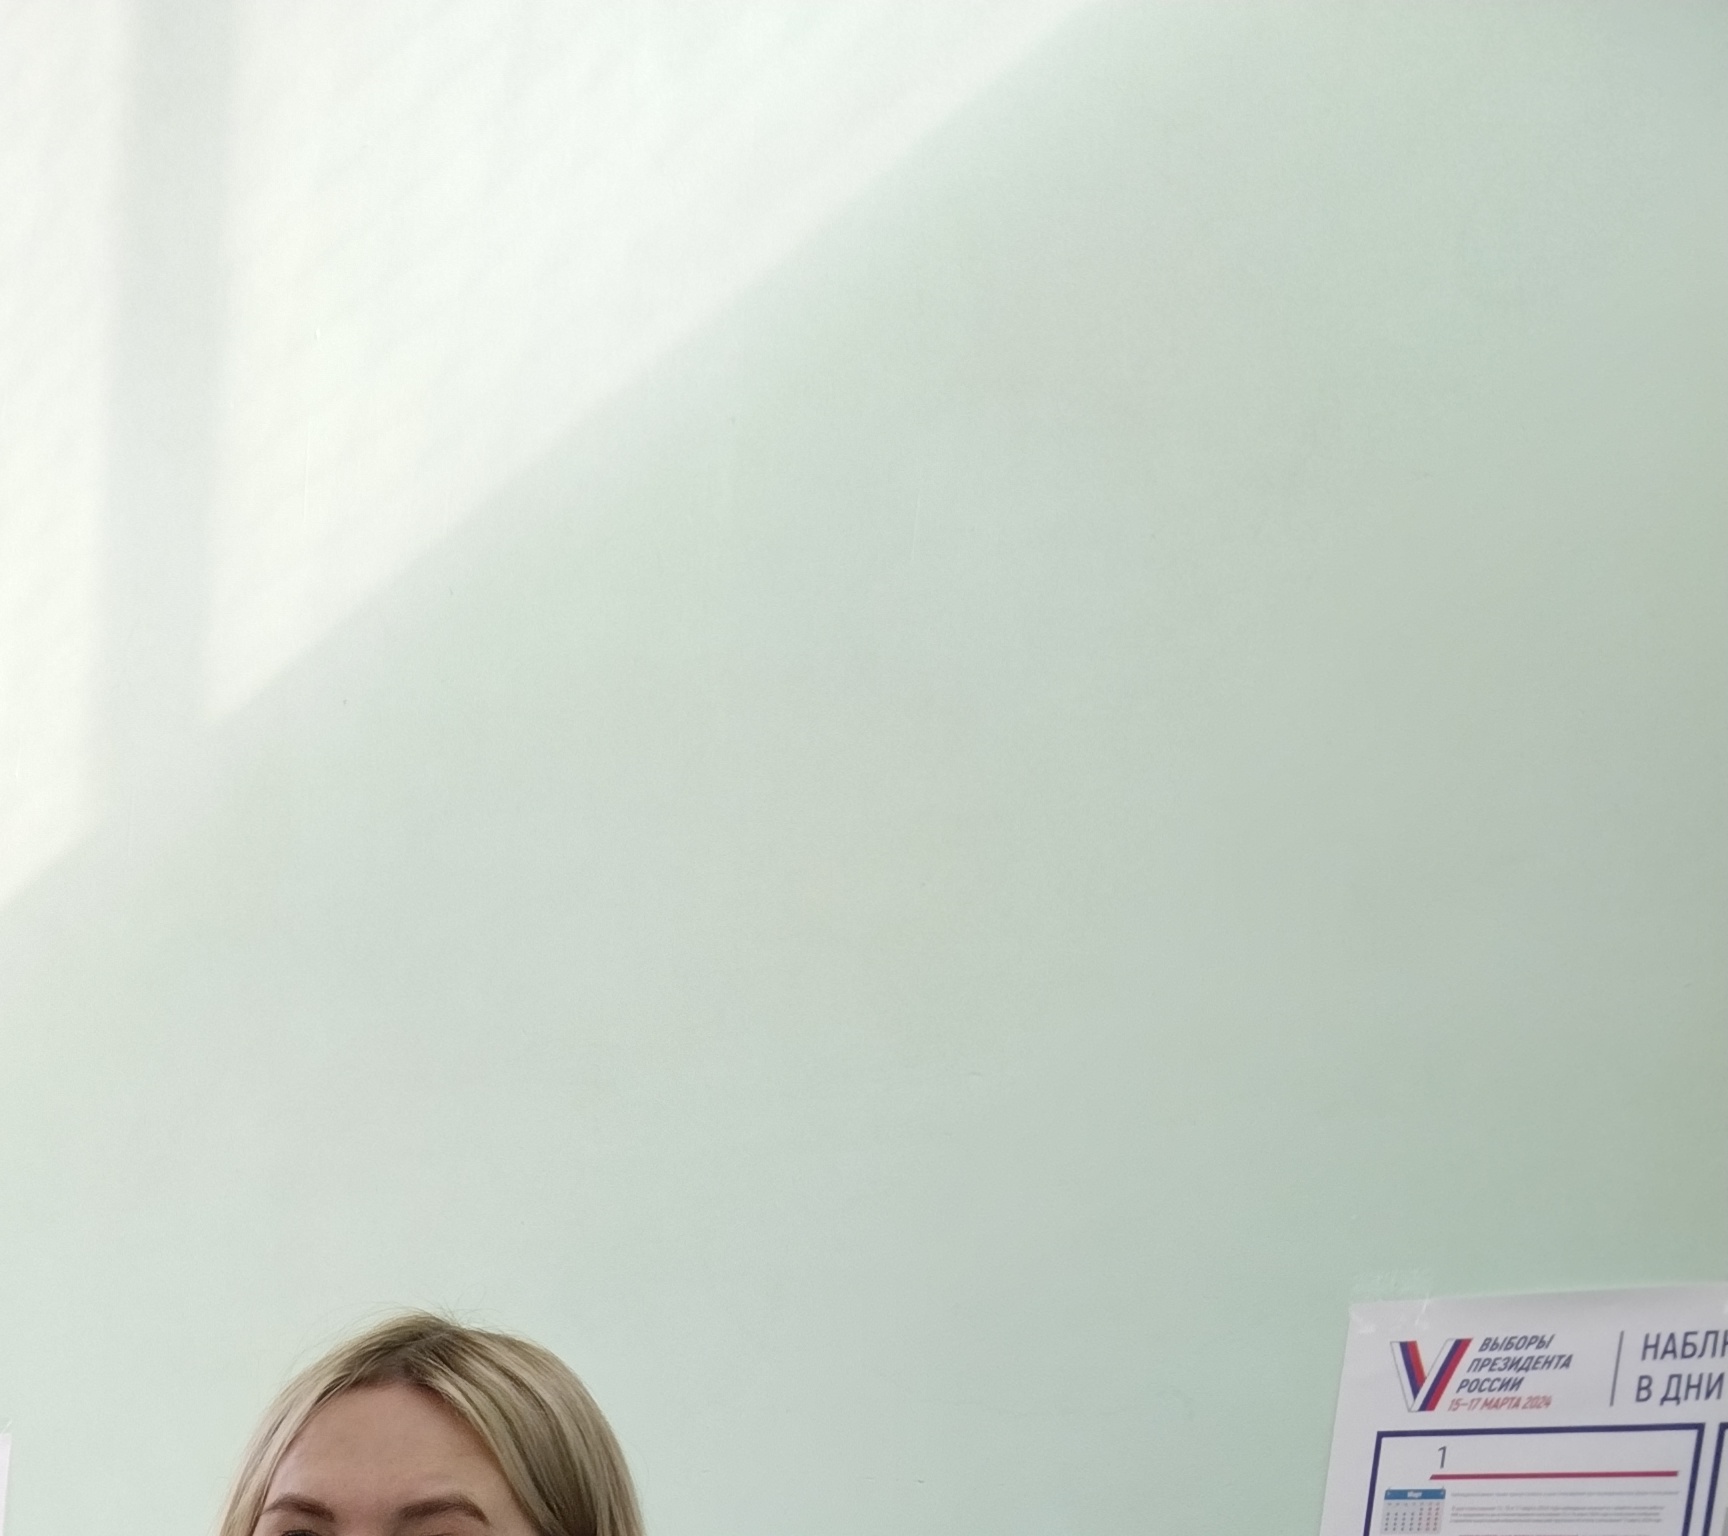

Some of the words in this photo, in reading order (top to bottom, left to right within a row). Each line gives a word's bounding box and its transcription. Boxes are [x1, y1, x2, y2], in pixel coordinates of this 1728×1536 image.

[1478, 1334, 1555, 1352] ВЫБОРЫ
[1467, 1354, 1573, 1373] ПРЕЗИДЕНТА
[1456, 1377, 1525, 1394] РОССИИ
[1635, 1375, 1652, 1402] В
[1660, 1371, 1725, 1406] ДНИ
[1479, 1396, 1521, 1411] МАРТА
[1522, 1395, 1553, 1410] 2024
[1437, 1445, 1448, 1469] 1
